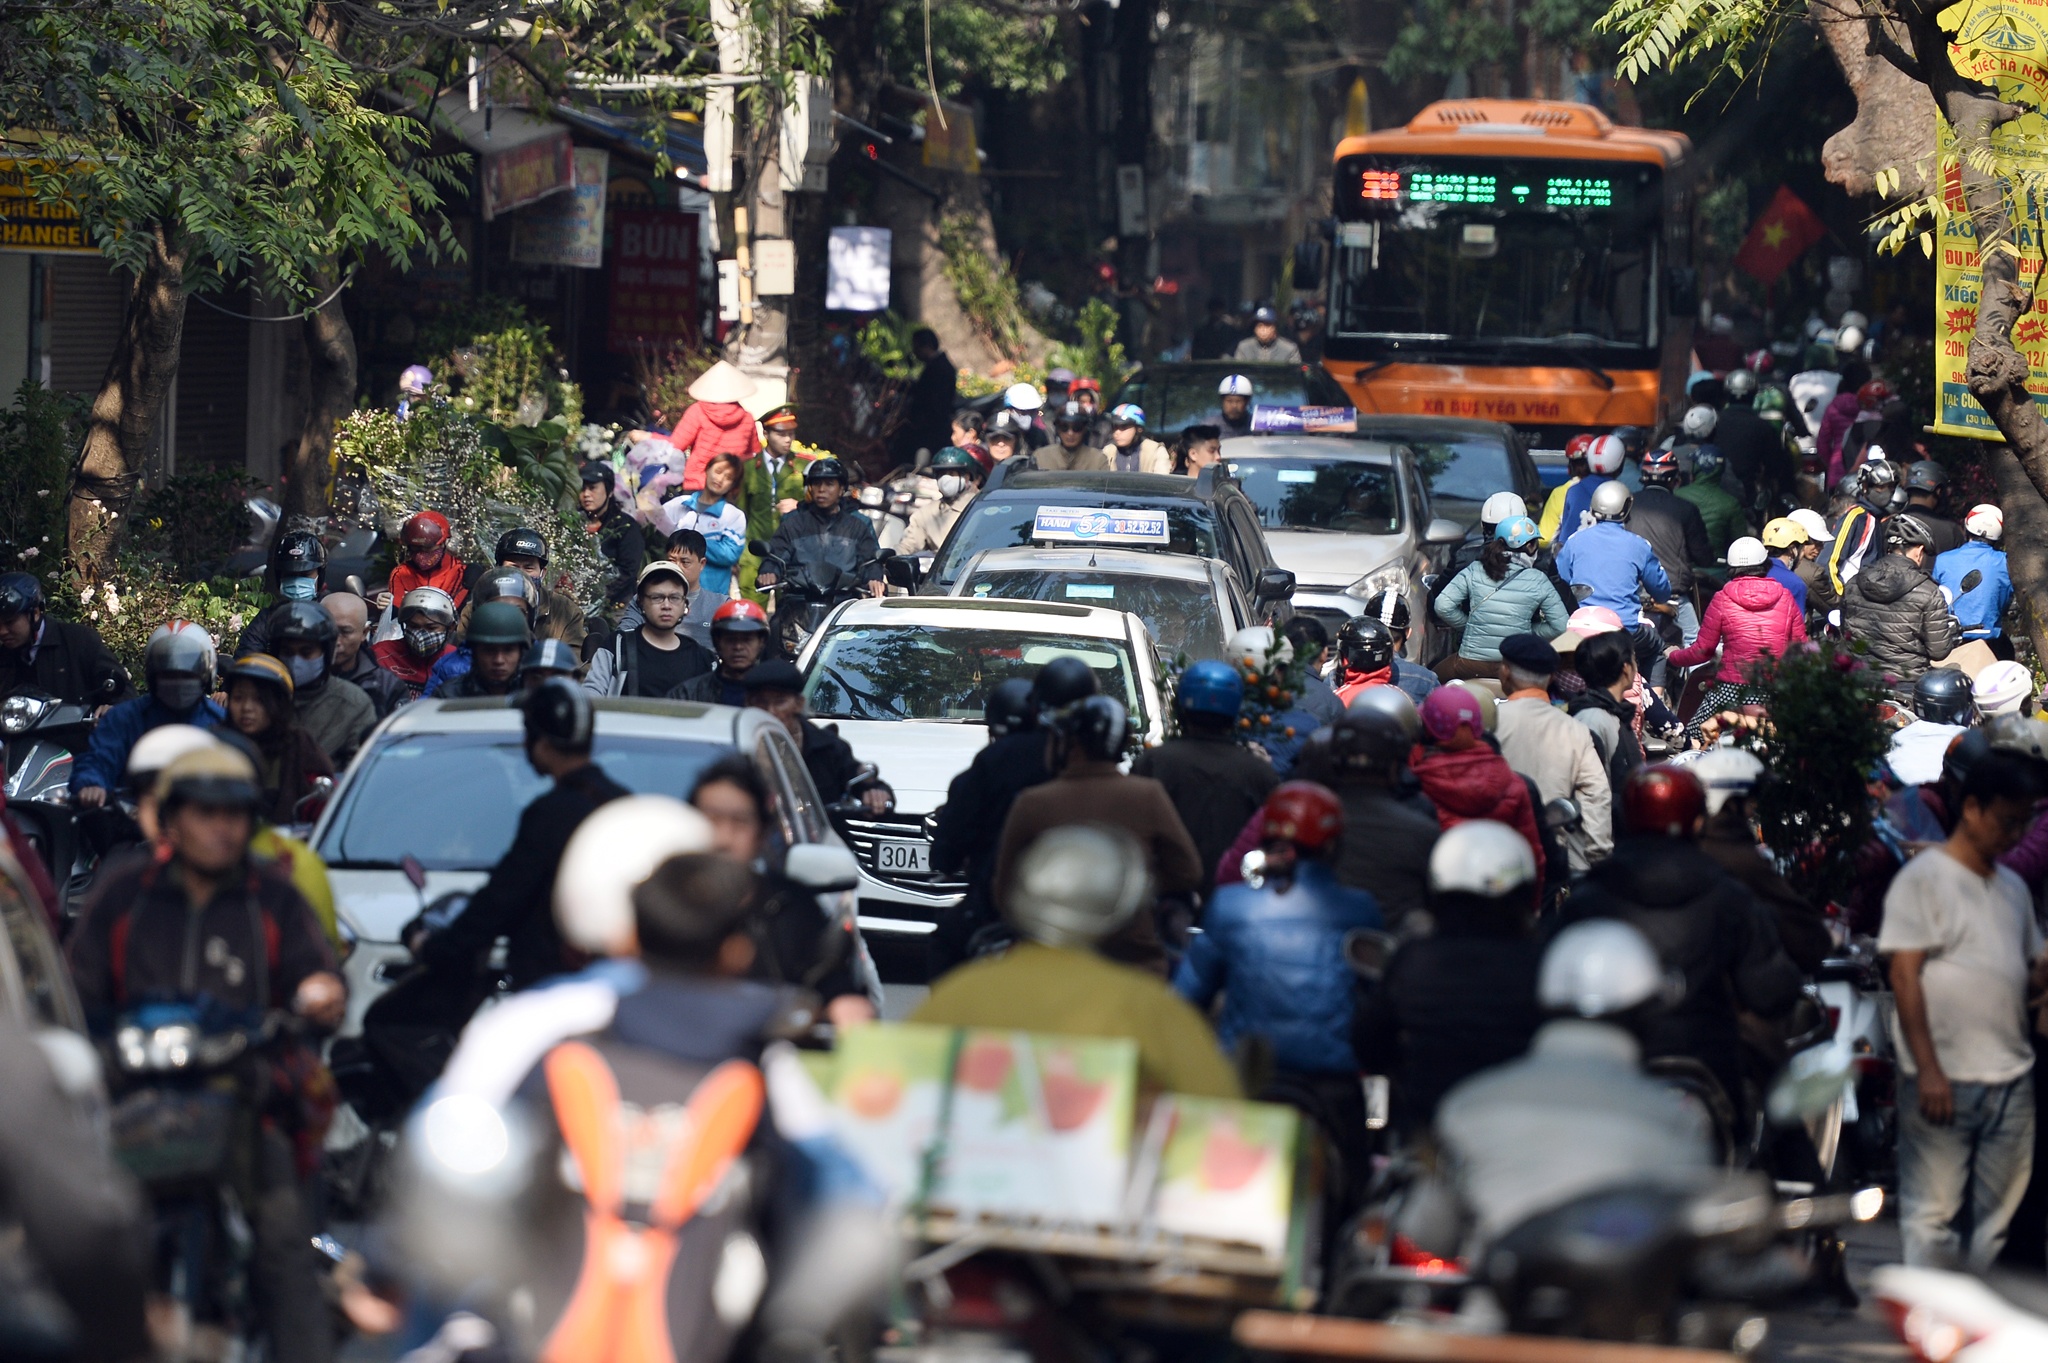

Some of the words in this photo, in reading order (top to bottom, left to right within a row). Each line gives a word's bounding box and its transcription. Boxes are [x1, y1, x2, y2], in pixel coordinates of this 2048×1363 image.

[1971, 55, 1996, 76] XIẾC
[2000, 58, 2017, 73] HÀ
[0, 199, 80, 219] OREIGN
[0, 224, 80, 245] HANGE
[621, 217, 690, 261] BÚN
[1945, 249, 1962, 266] ĐU
[2020, 257, 2046, 275] CAO
[1944, 284, 1978, 304] Xiếc
[1945, 340, 1965, 357] 20h
[2027, 350, 2048, 367] 12/
[1077, 515, 1108, 533] 52
[1114, 520, 1161, 535] 38.52.52.52
